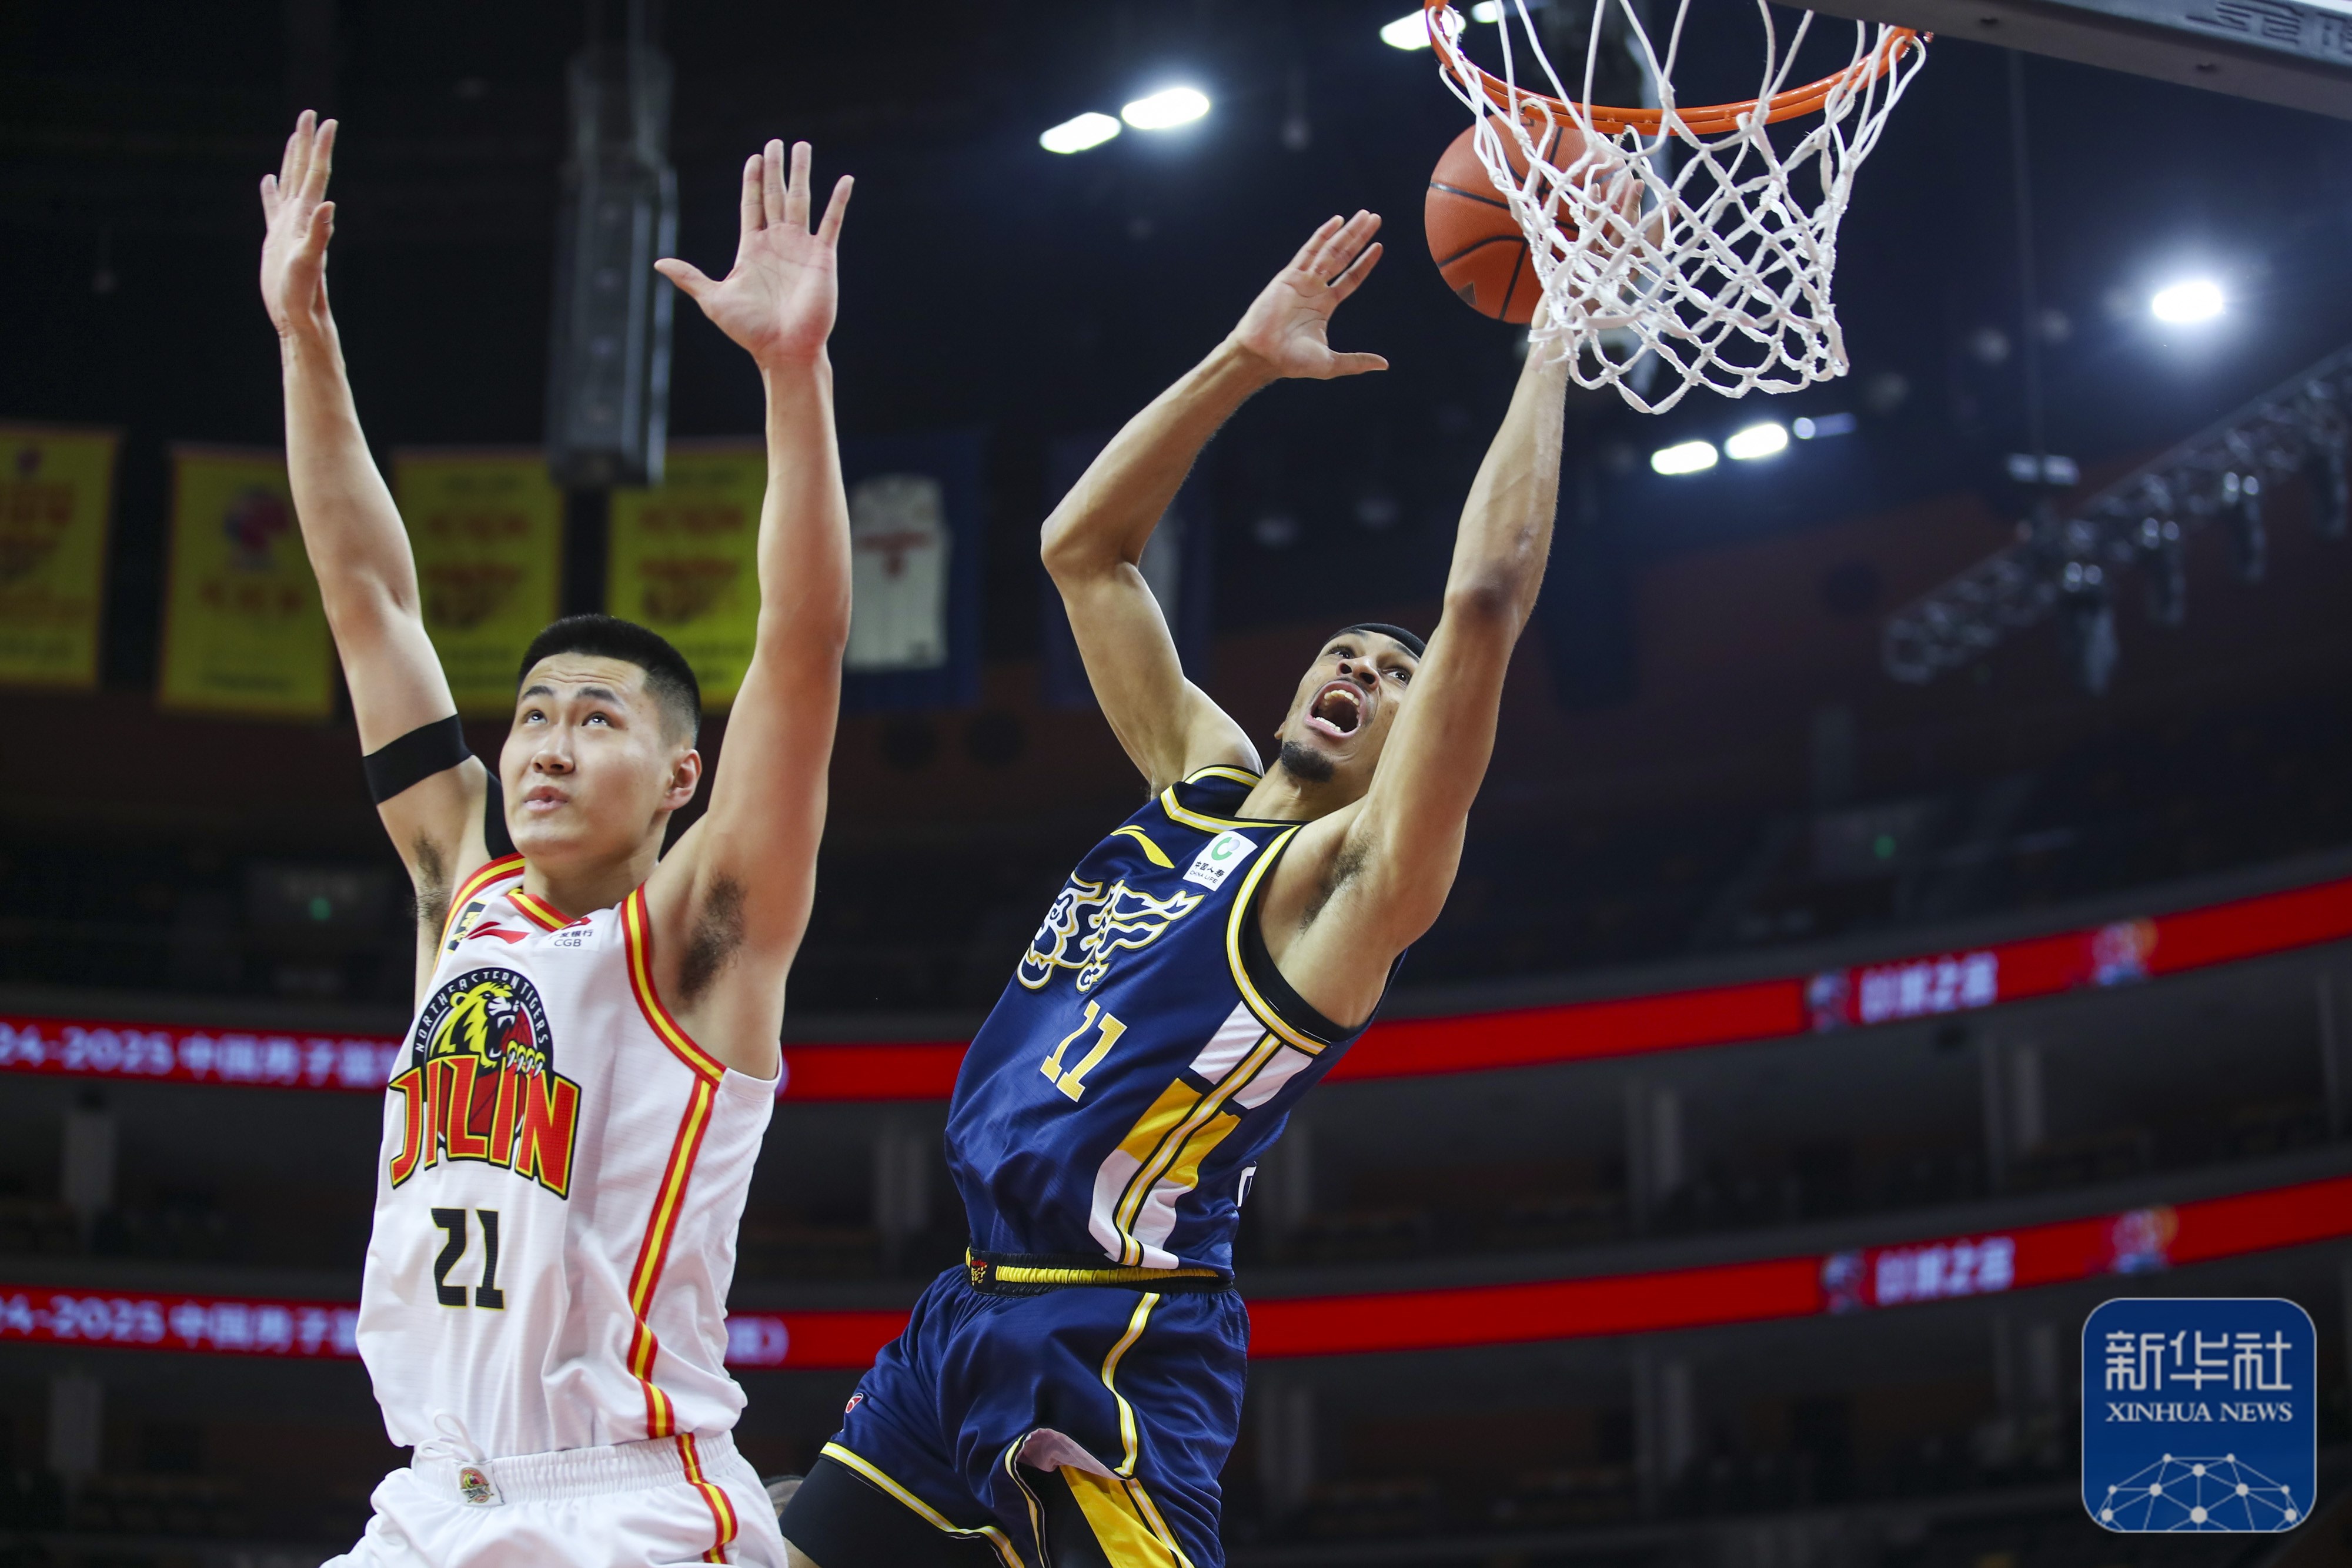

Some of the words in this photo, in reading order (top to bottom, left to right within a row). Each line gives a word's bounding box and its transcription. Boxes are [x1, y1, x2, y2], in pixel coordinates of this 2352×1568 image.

[1195, 861, 1225, 878] 中国人寿
[1204, 873, 1218, 884] LIFE
[554, 938, 582, 947] CGB
[520, 982, 549, 1044] TIGERS
[1040, 999, 1128, 1102] 11
[387, 1052, 582, 1201] JILIN
[430, 1207, 505, 1310] 21
